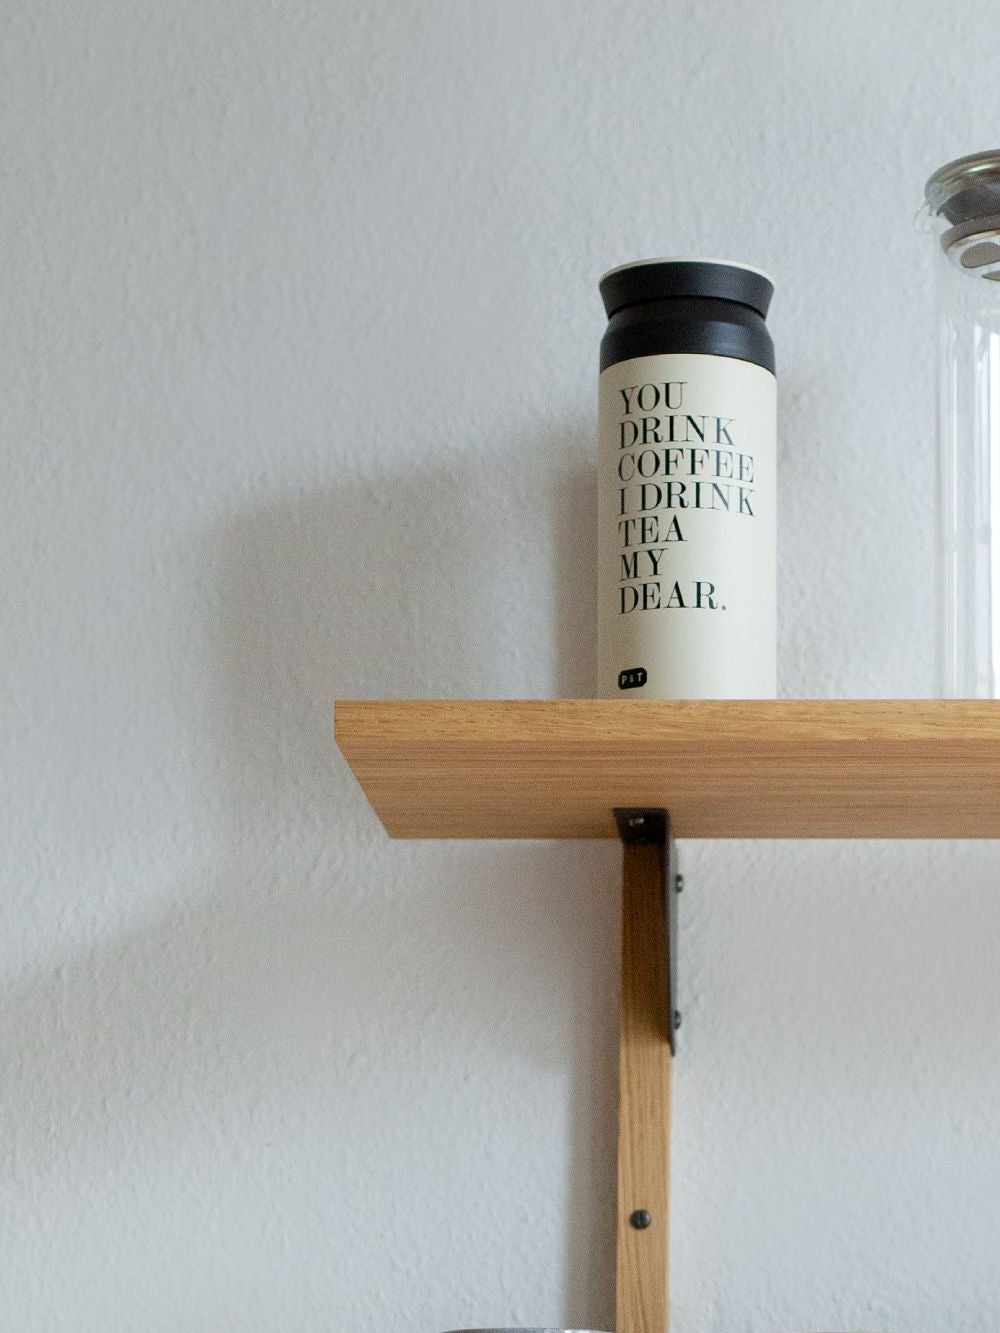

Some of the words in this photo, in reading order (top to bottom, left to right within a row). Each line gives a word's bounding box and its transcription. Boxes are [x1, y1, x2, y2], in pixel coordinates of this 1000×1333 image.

[618, 382, 687, 416] YOU
[618, 415, 737, 450] DRINK
[618, 448, 755, 484] COFFEE
[618, 488, 629, 516] I
[637, 481, 757, 518] DRINK
[618, 514, 688, 548] TEA
[618, 548, 669, 582] MY
[618, 581, 728, 616] DEAR.
